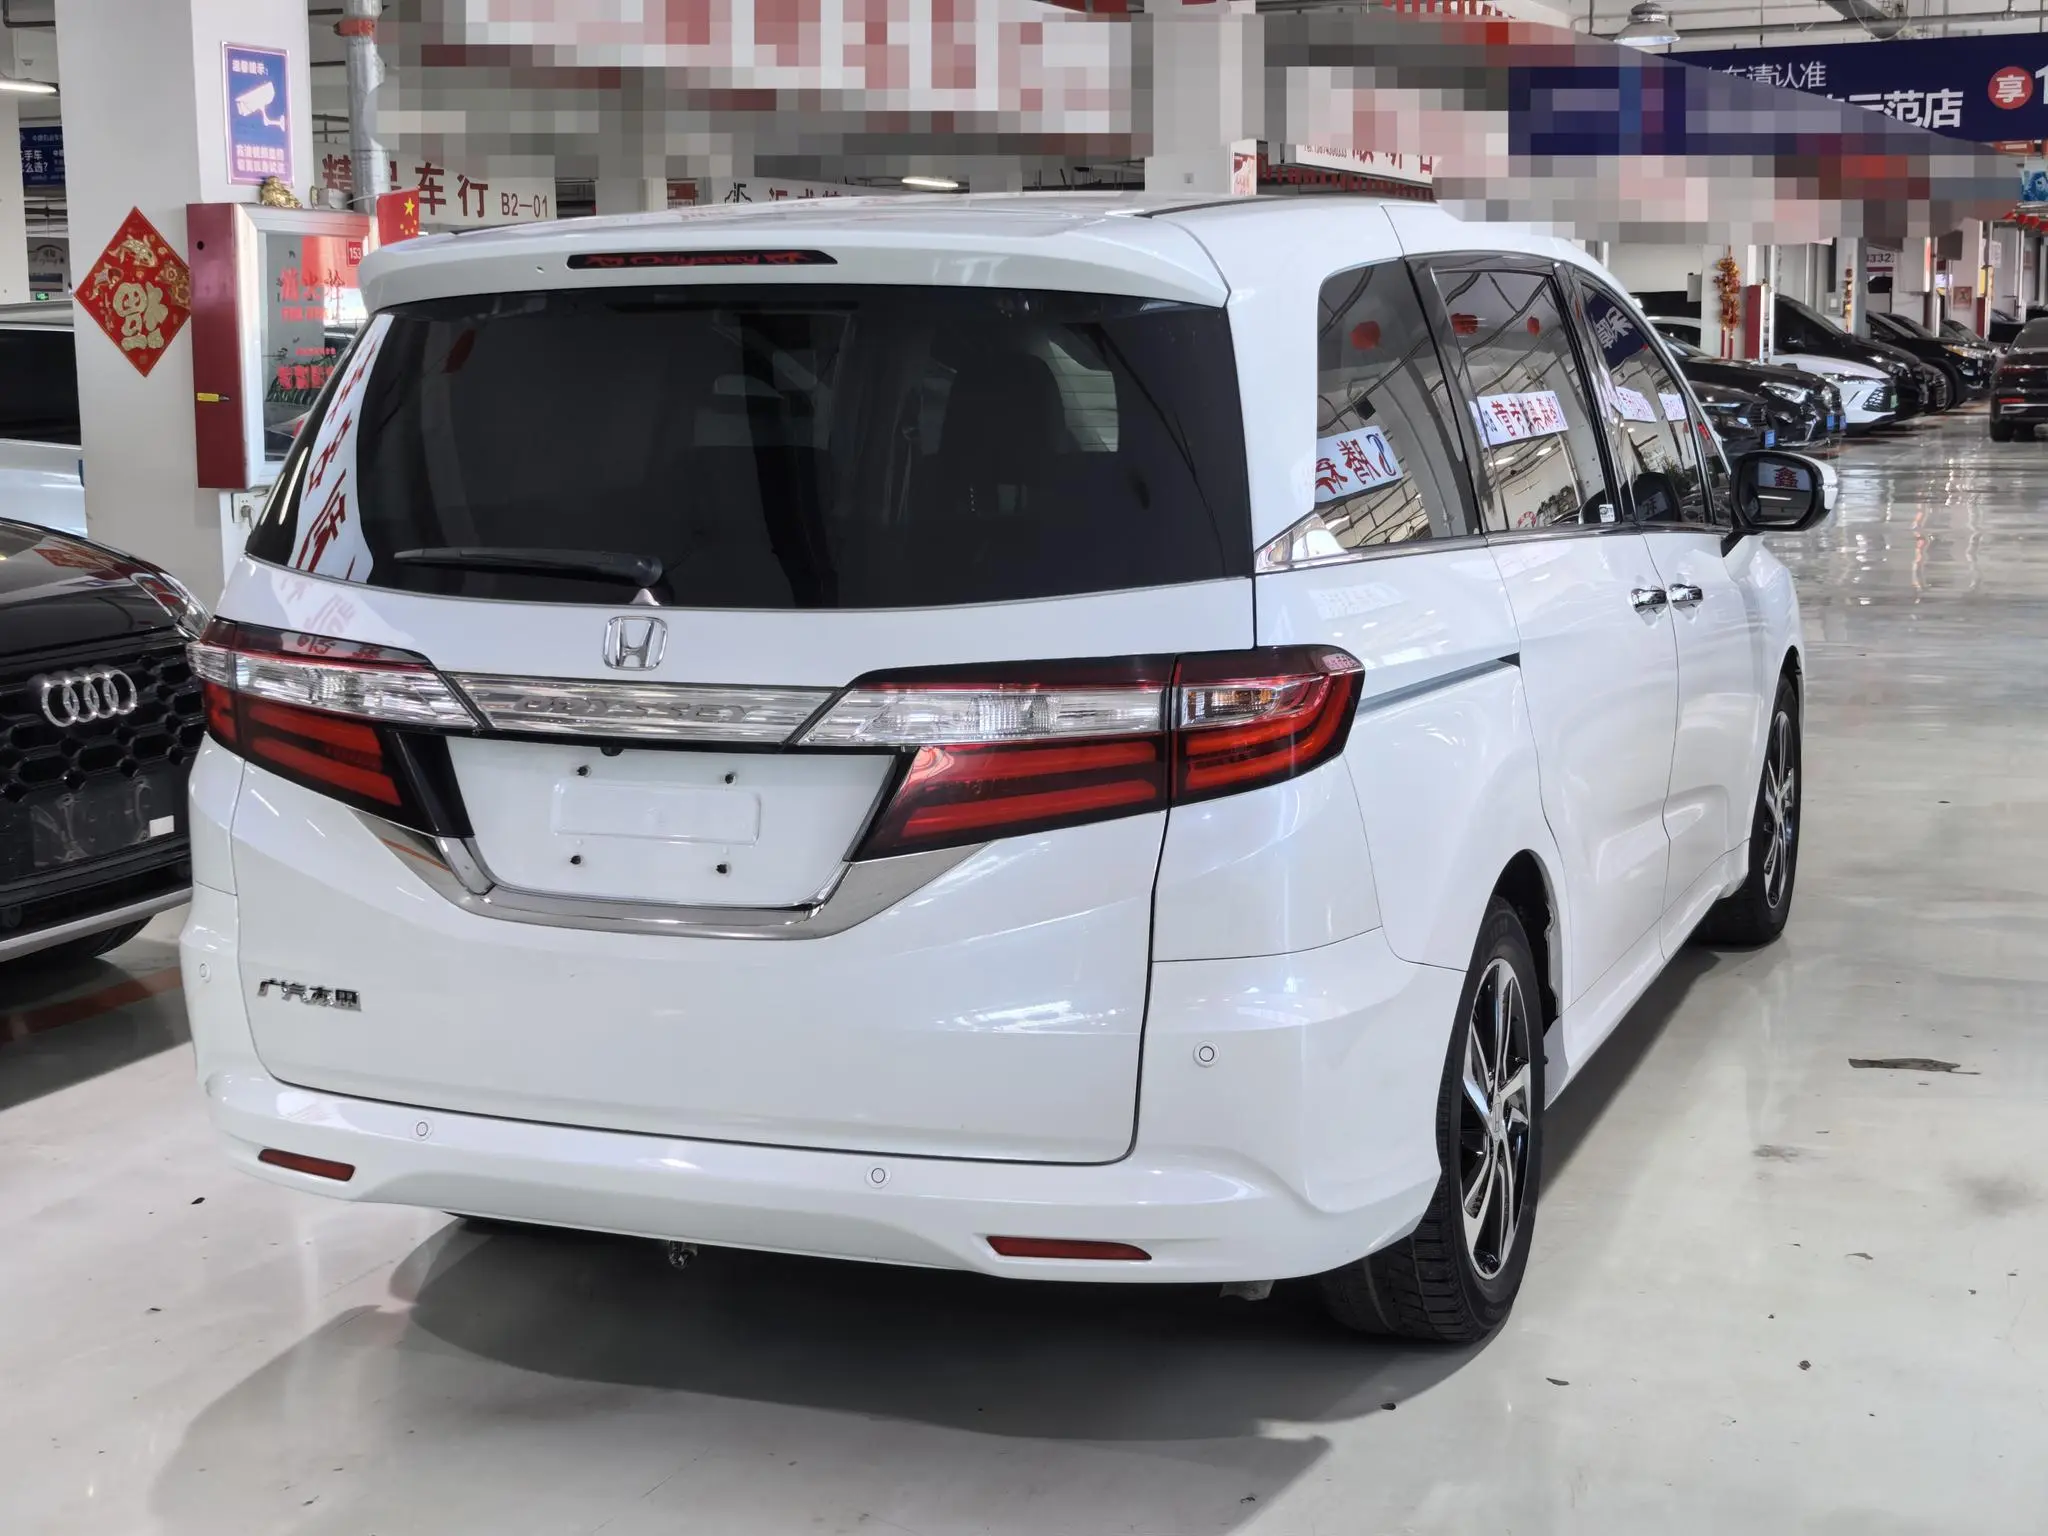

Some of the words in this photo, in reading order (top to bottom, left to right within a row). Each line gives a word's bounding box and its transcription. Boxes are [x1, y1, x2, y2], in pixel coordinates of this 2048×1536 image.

[1995, 73, 2025, 104] 享
[257, 977, 362, 1012] 广汽本田
